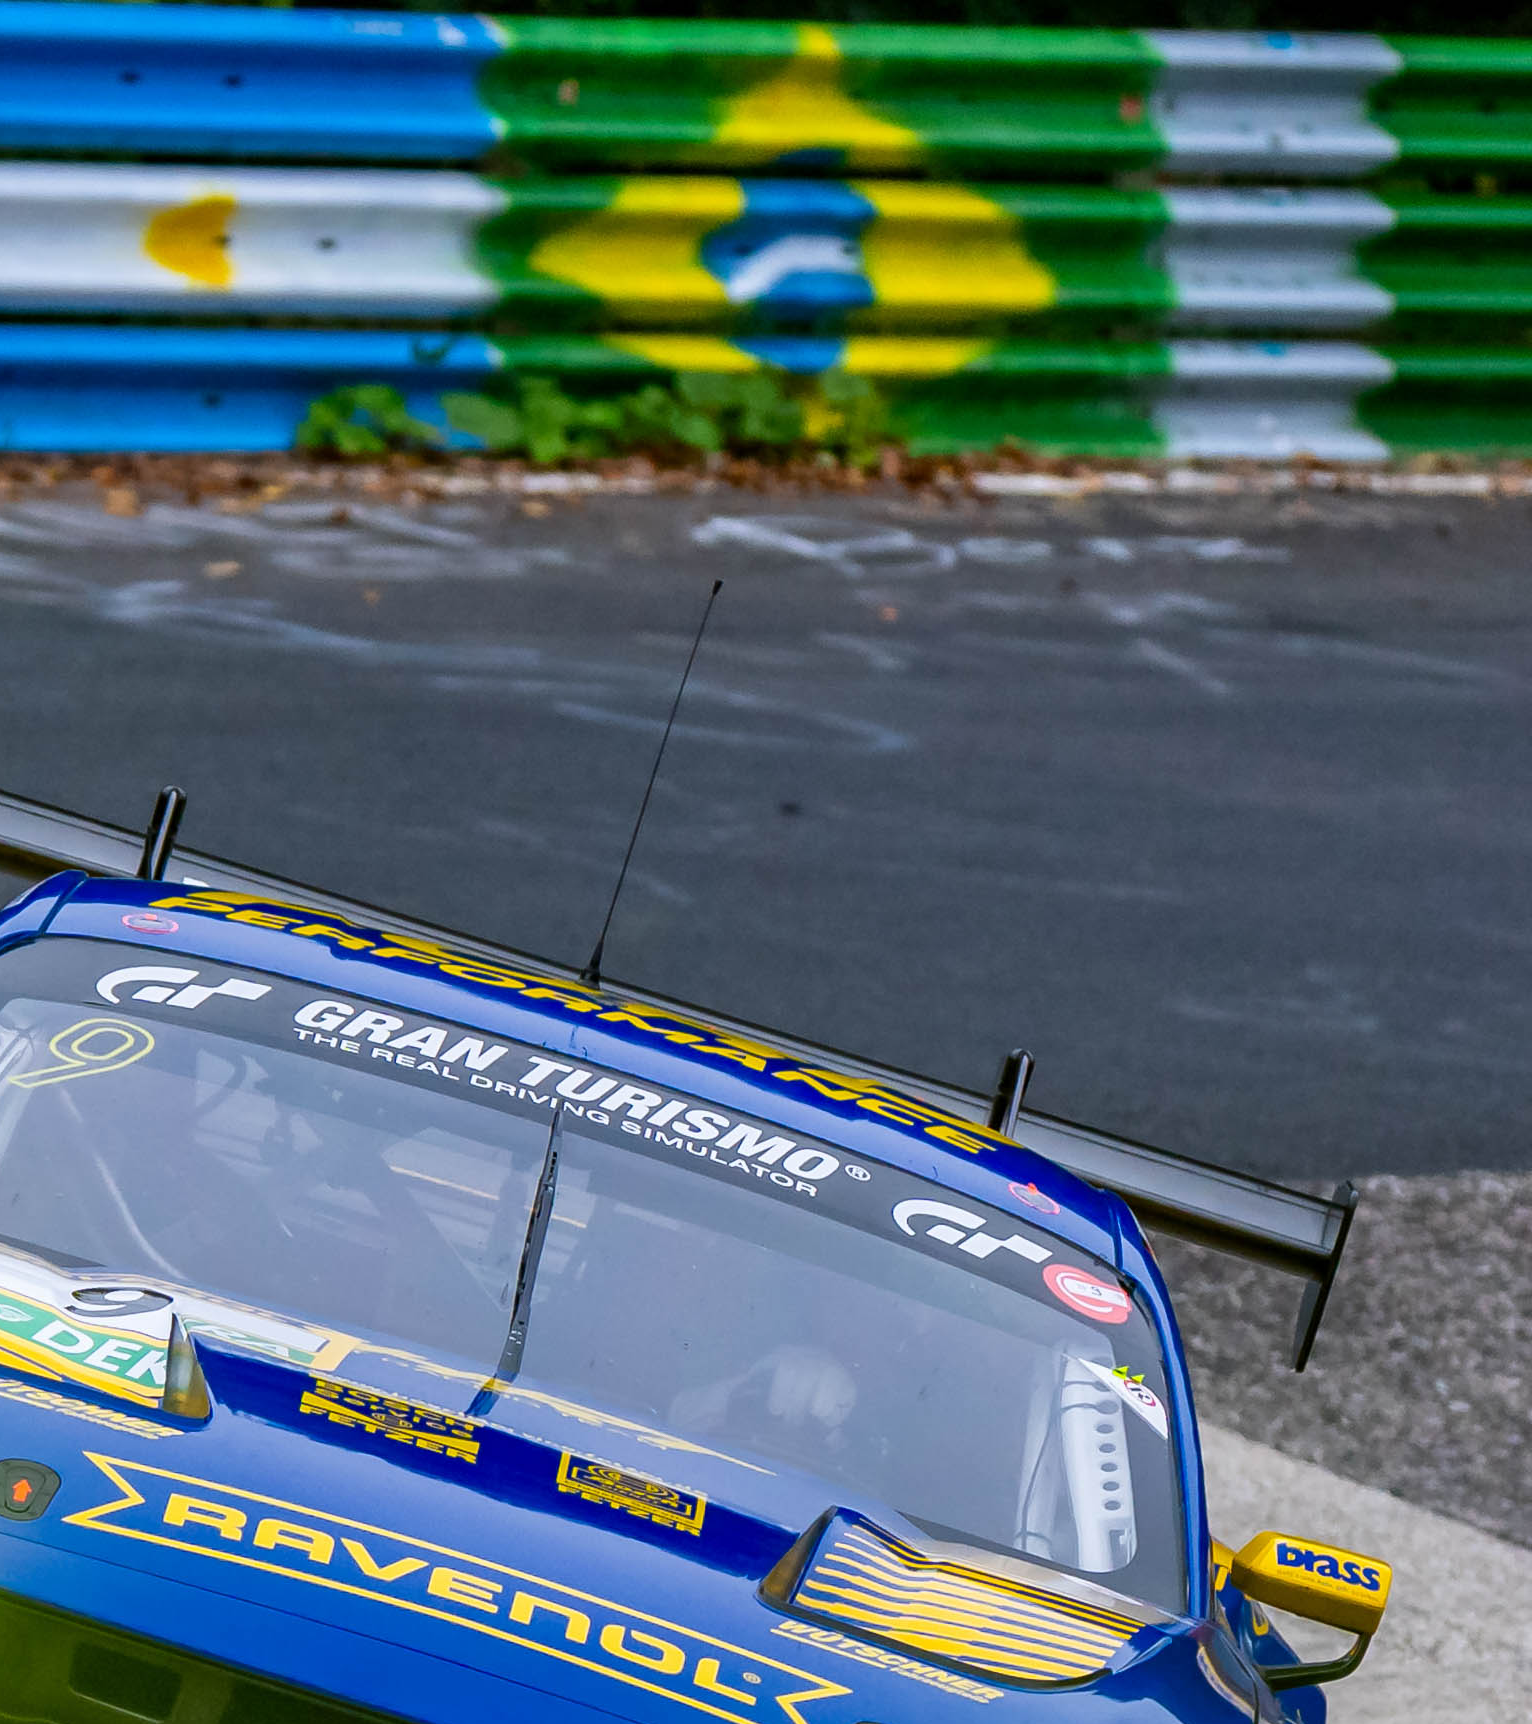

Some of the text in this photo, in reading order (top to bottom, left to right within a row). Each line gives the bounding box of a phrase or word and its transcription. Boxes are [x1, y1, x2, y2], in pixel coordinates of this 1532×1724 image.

[9, 1018, 155, 1089] 9
[149, 896, 997, 1154] PERFORMANCE
[293, 1000, 508, 1071] GRAN
[293, 1027, 817, 1197] THE REAL DRIVING SIMULATOR
[300, 1403, 477, 1464] FETZER
[557, 1483, 700, 1537] FETZER
[1276, 1543, 1381, 1591] brass
